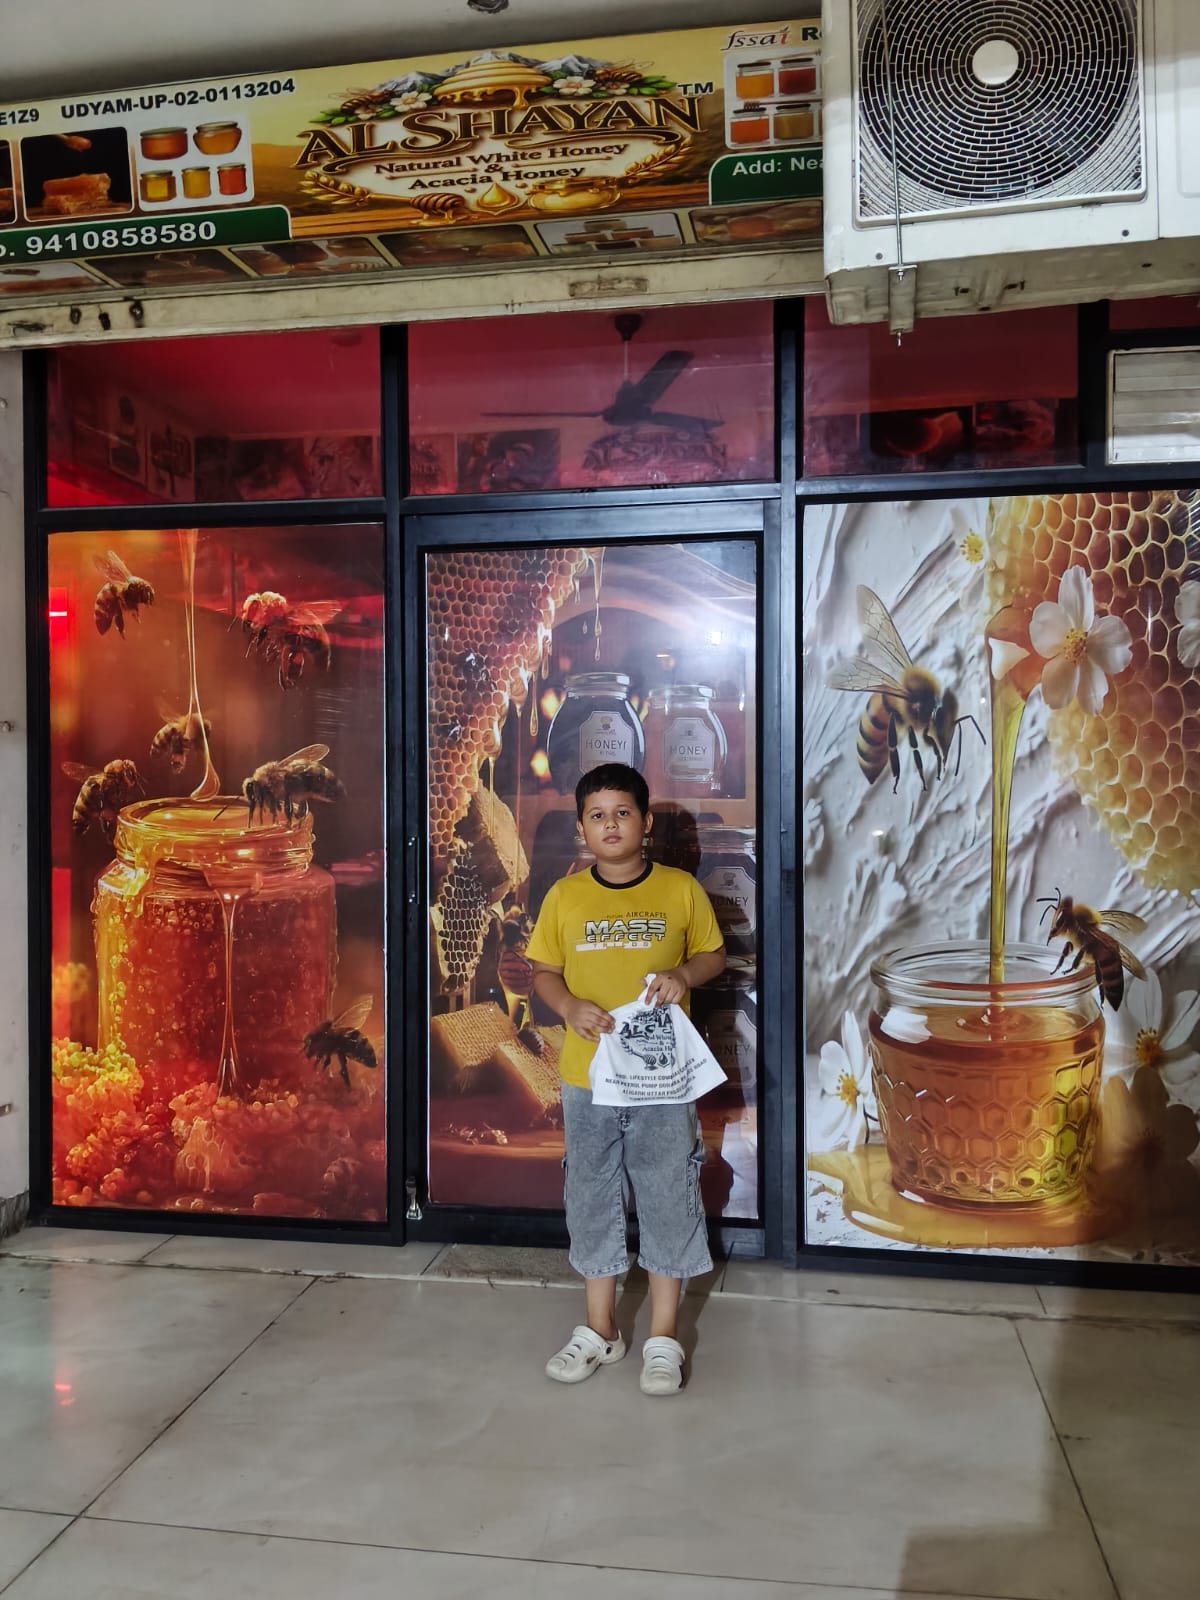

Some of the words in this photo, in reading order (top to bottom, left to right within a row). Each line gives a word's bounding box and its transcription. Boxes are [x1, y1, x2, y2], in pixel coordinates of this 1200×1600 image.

[721, 24, 791, 51] fssai
[61, 77, 296, 120] UDYAM-UP-02-0113204
[677, 81, 714, 96] TM
[399, 96, 707, 156] SHAYAN
[373, 155, 462, 175] Natural
[466, 148, 542, 166] White
[547, 142, 631, 160] Honey
[483, 162, 502, 174] &
[732, 159, 783, 177] Add:
[407, 173, 494, 191] Acacia
[500, 165, 587, 183] Honey
[26, 221, 217, 257] 9410858580
[670, 745, 708, 756] HONEY
[585, 918, 668, 936] MASS
[586, 933, 665, 943] EFFECT
